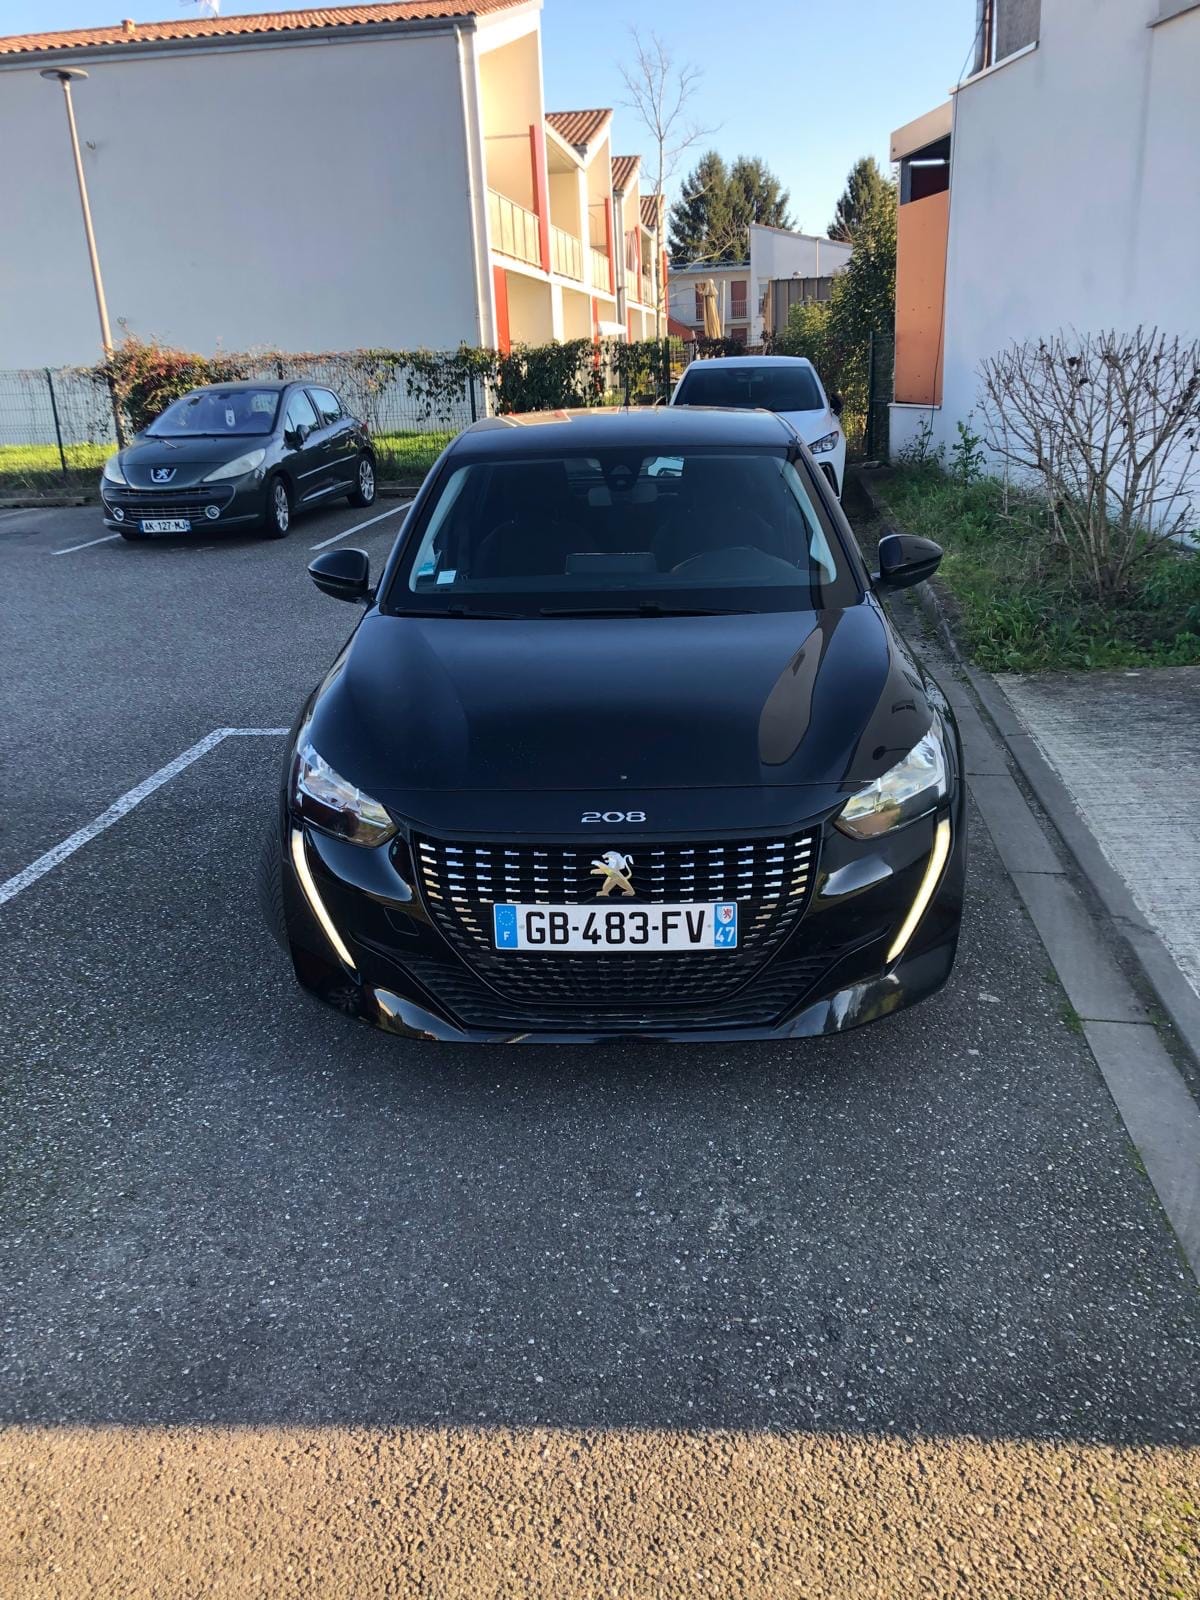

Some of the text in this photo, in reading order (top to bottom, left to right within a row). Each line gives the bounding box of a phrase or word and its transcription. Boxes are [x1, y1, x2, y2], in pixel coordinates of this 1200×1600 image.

[580, 811, 647, 823] 208
[503, 910, 735, 945] F GB-483-FV 47
